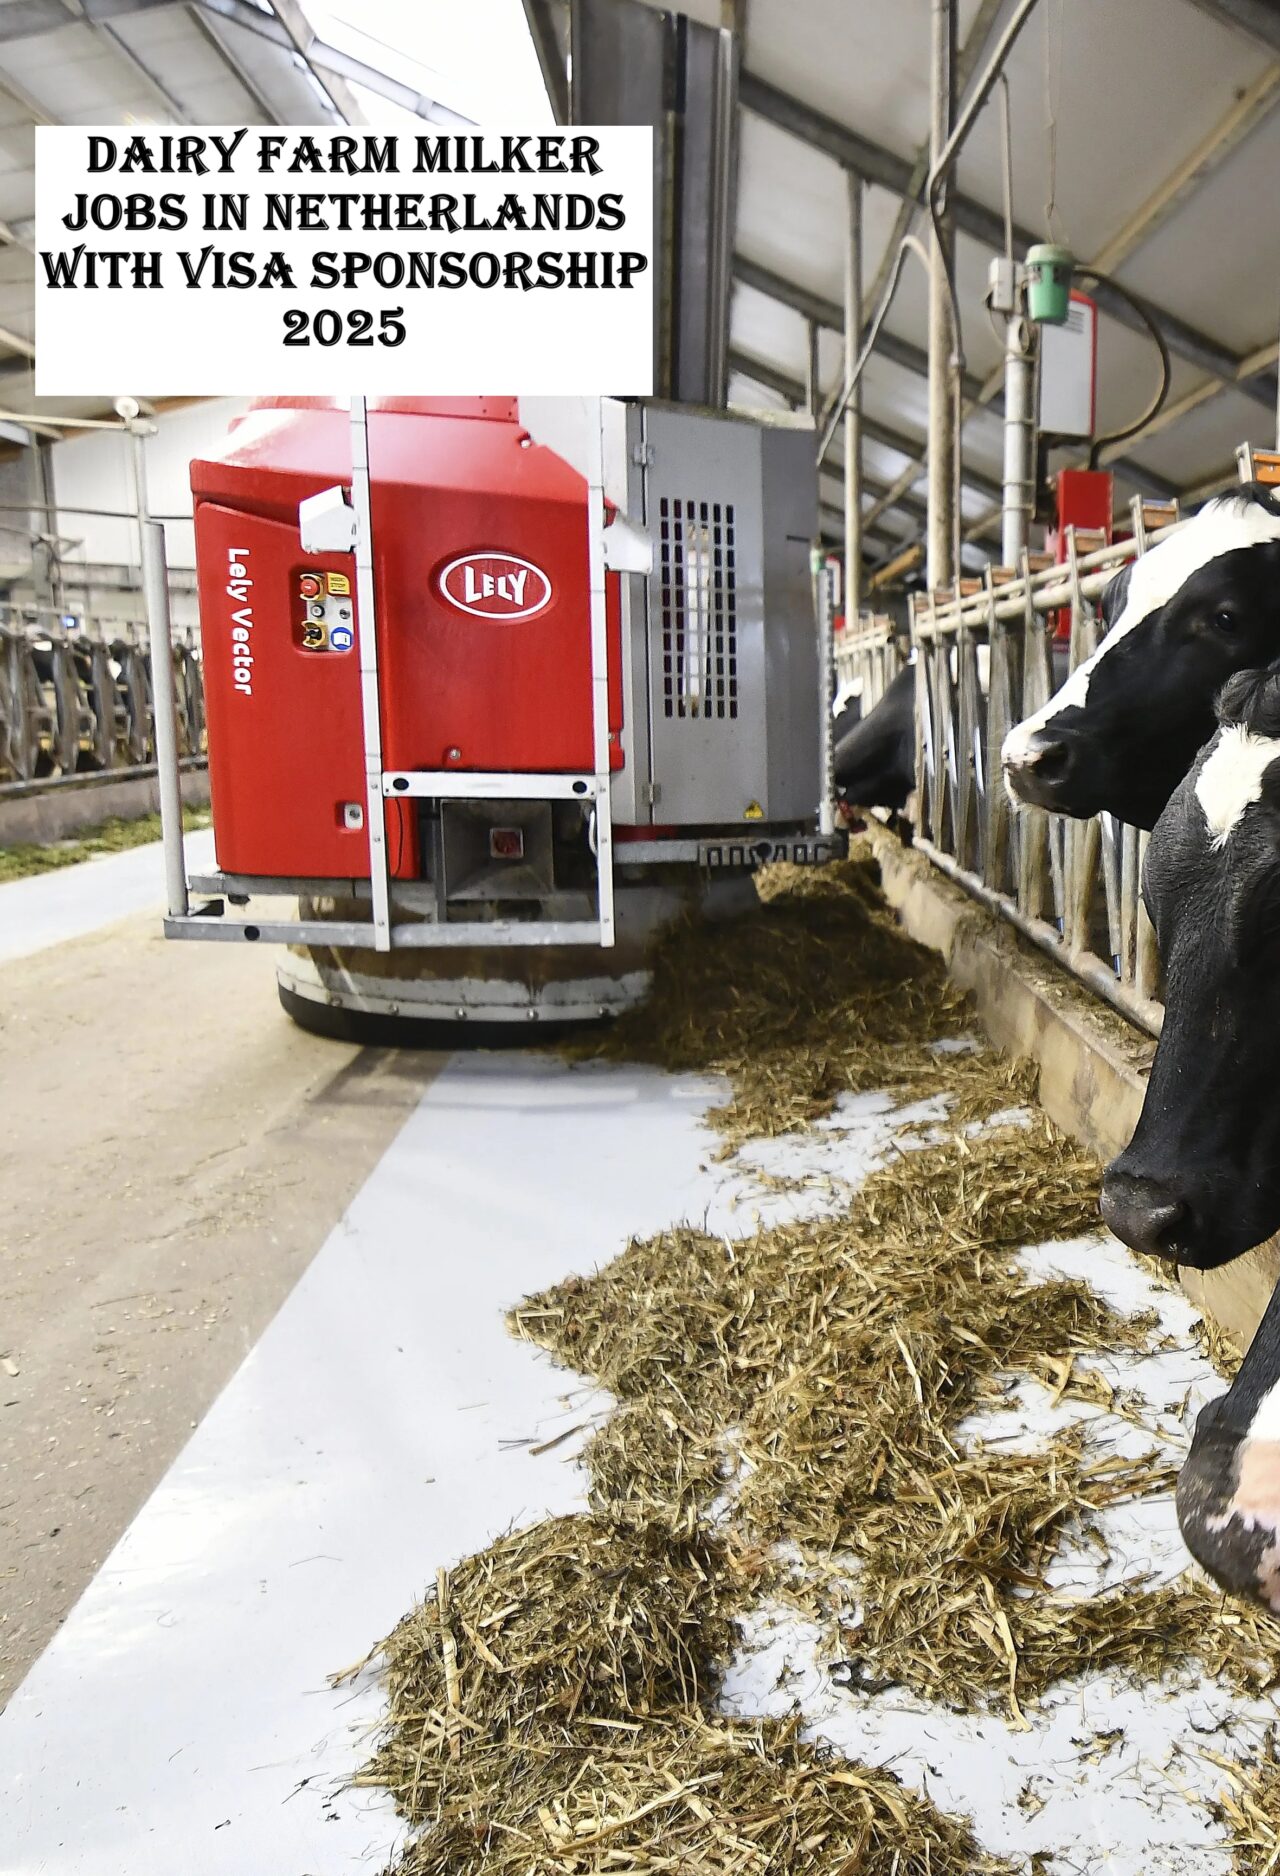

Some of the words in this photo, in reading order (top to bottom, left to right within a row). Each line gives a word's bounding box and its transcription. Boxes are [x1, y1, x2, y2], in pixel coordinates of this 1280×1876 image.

[226, 548, 253, 602] Lely
[464, 565, 528, 604] LELY
[231, 608, 254, 695] Vector
